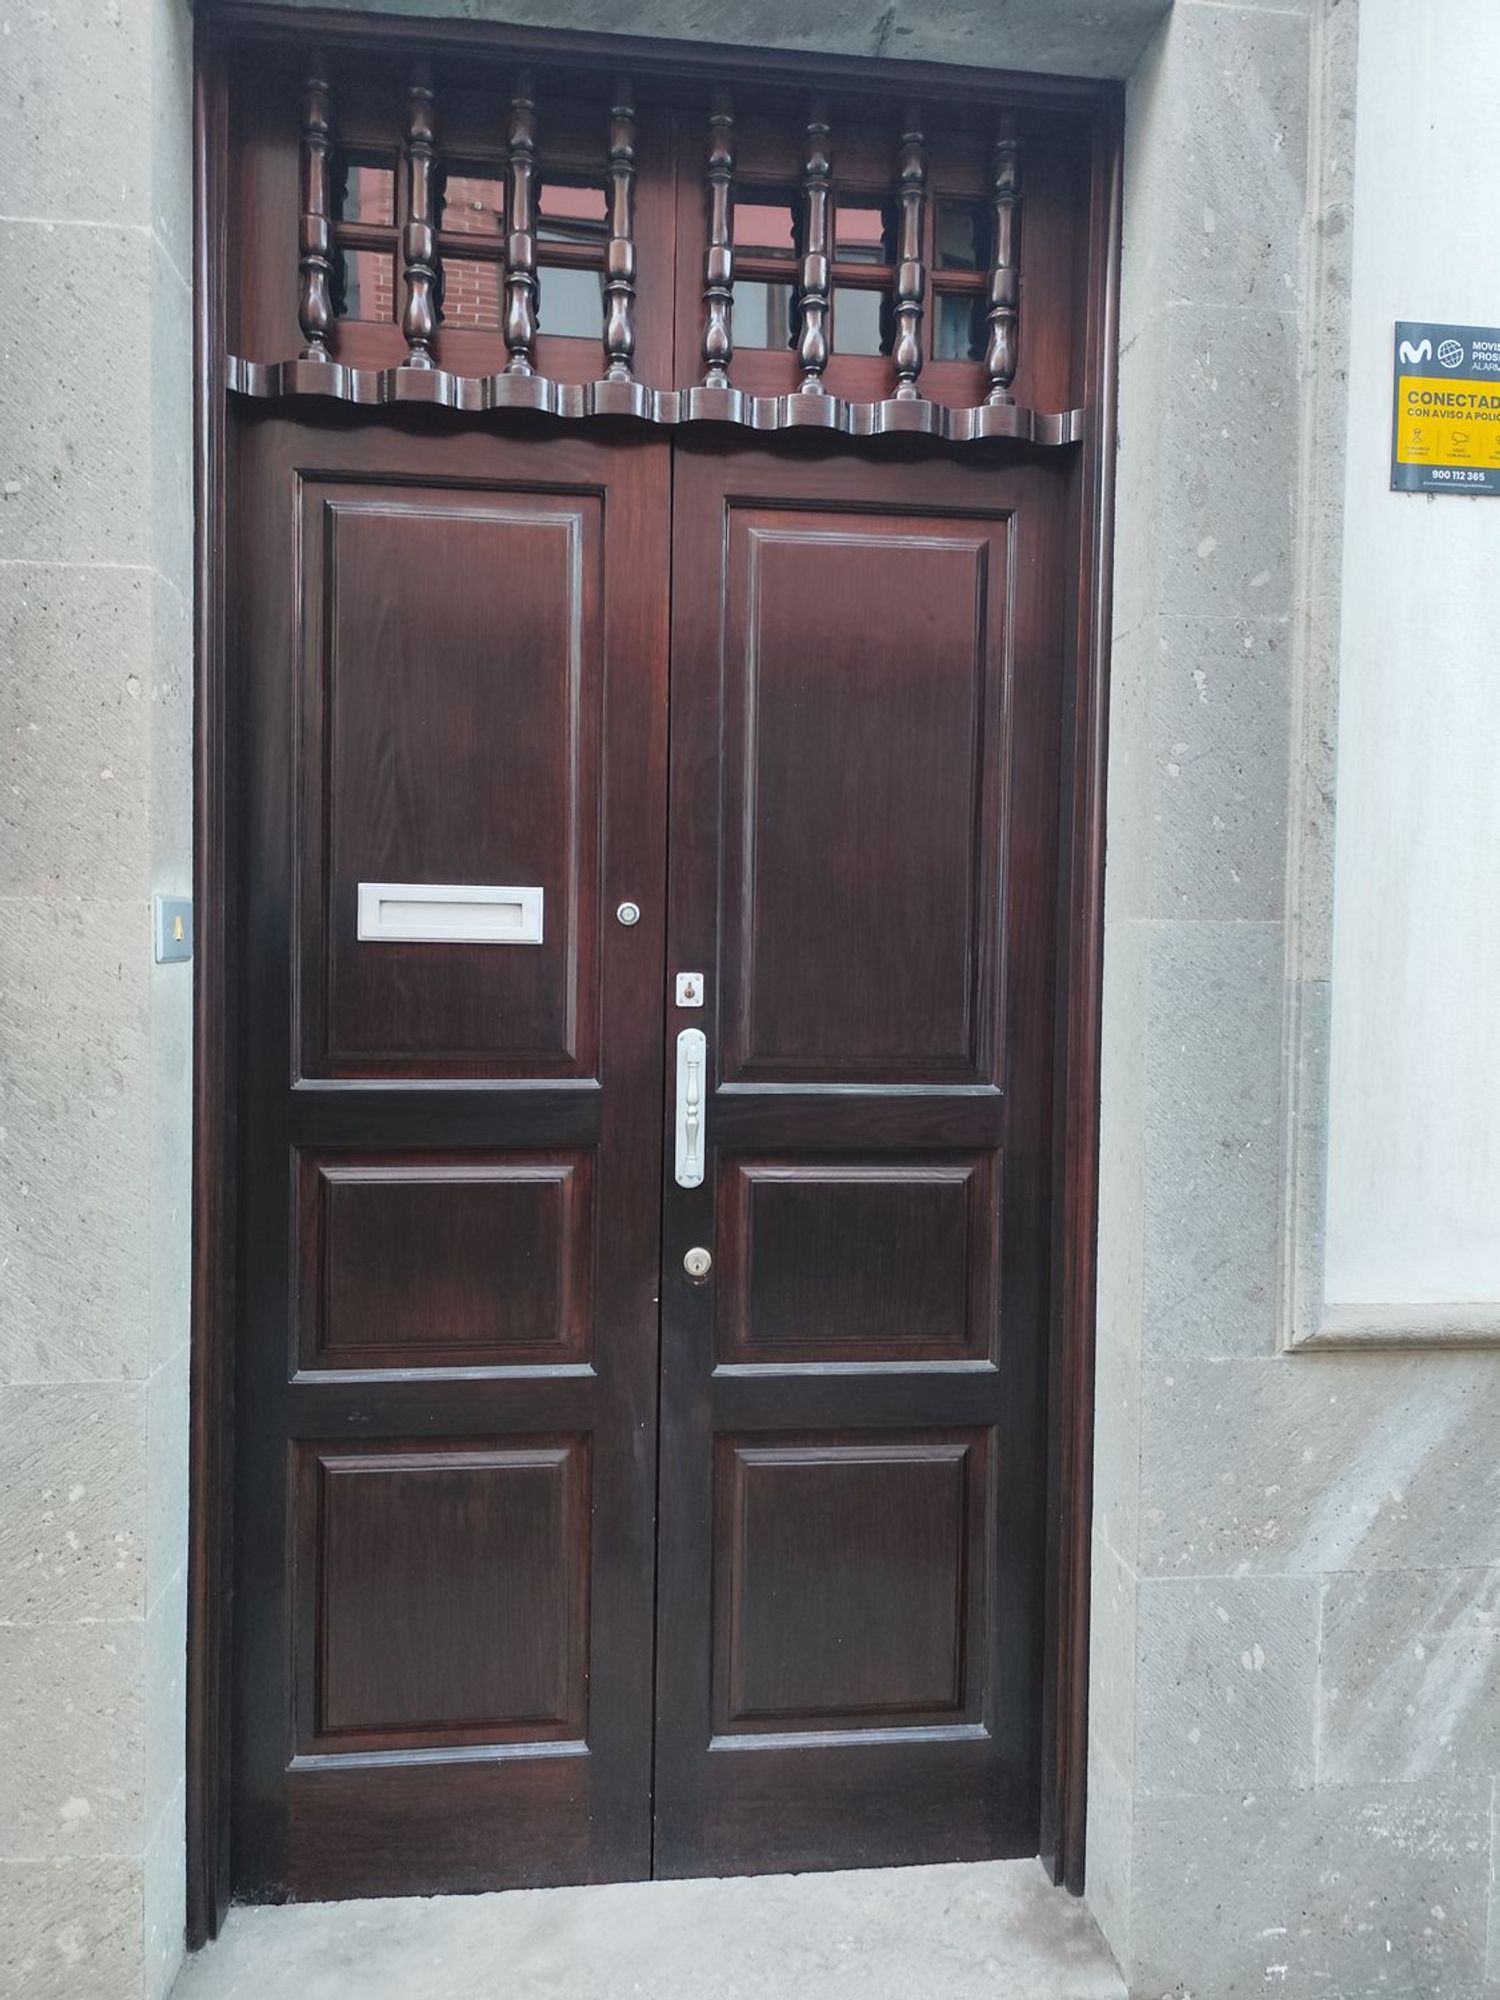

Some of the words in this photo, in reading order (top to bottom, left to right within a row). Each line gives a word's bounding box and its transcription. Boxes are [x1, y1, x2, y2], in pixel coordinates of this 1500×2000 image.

[1472, 351, 1500, 362] PROS
[1407, 391, 1500, 410] CONECTAD
[1407, 409, 1430, 418] CON
[1432, 410, 1464, 420] AVISO
[1465, 411, 1473, 420] A
[1432, 470, 1451, 480] 900
[1452, 471, 1466, 481] 112
[1467, 472, 1486, 482] 365
